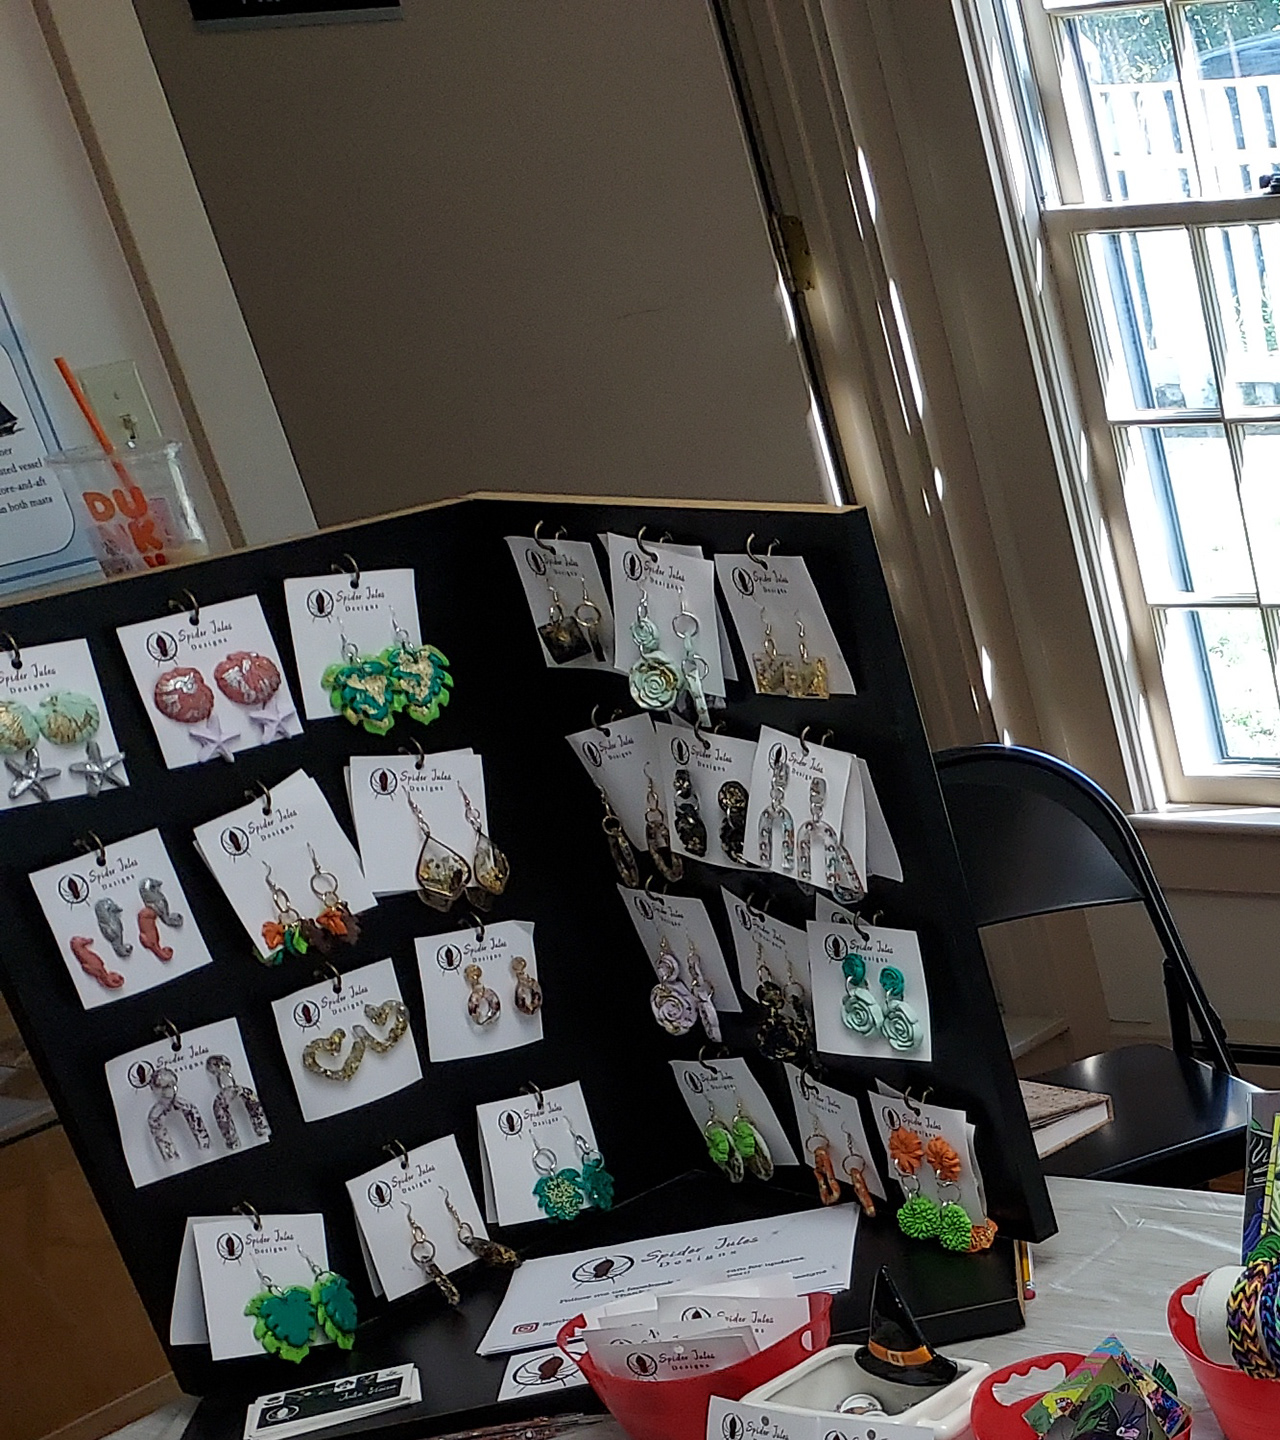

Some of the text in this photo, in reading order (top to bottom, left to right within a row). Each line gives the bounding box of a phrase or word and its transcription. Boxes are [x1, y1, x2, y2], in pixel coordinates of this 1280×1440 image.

[336, 586, 385, 605] Spider Jules
[345, 604, 379, 612] Designs
[178, 620, 232, 644] Spider Jules
[191, 638, 227, 650] Designs
[31, 664, 56, 676] Jules
[10, 683, 50, 694] Designs
[400, 769, 452, 787] Spider Jules
[409, 785, 444, 793] Designs
[247, 808, 298, 836] Spider Jules
[261, 825, 294, 842] Designs
[88, 857, 138, 884] Spider Jules
[102, 874, 135, 891] Designs
[863, 955, 888, 963] esigns
[245, 1229, 294, 1247] Spider Jules
[255, 1245, 287, 1255] Designs
[641, 1235, 759, 1265] Spider Jules
[752, 1311, 774, 1324] Jules
[659, 1350, 716, 1364] Spider Jules
[672, 1363, 710, 1371] Designs
[746, 1422, 789, 1440] Spider Jules
